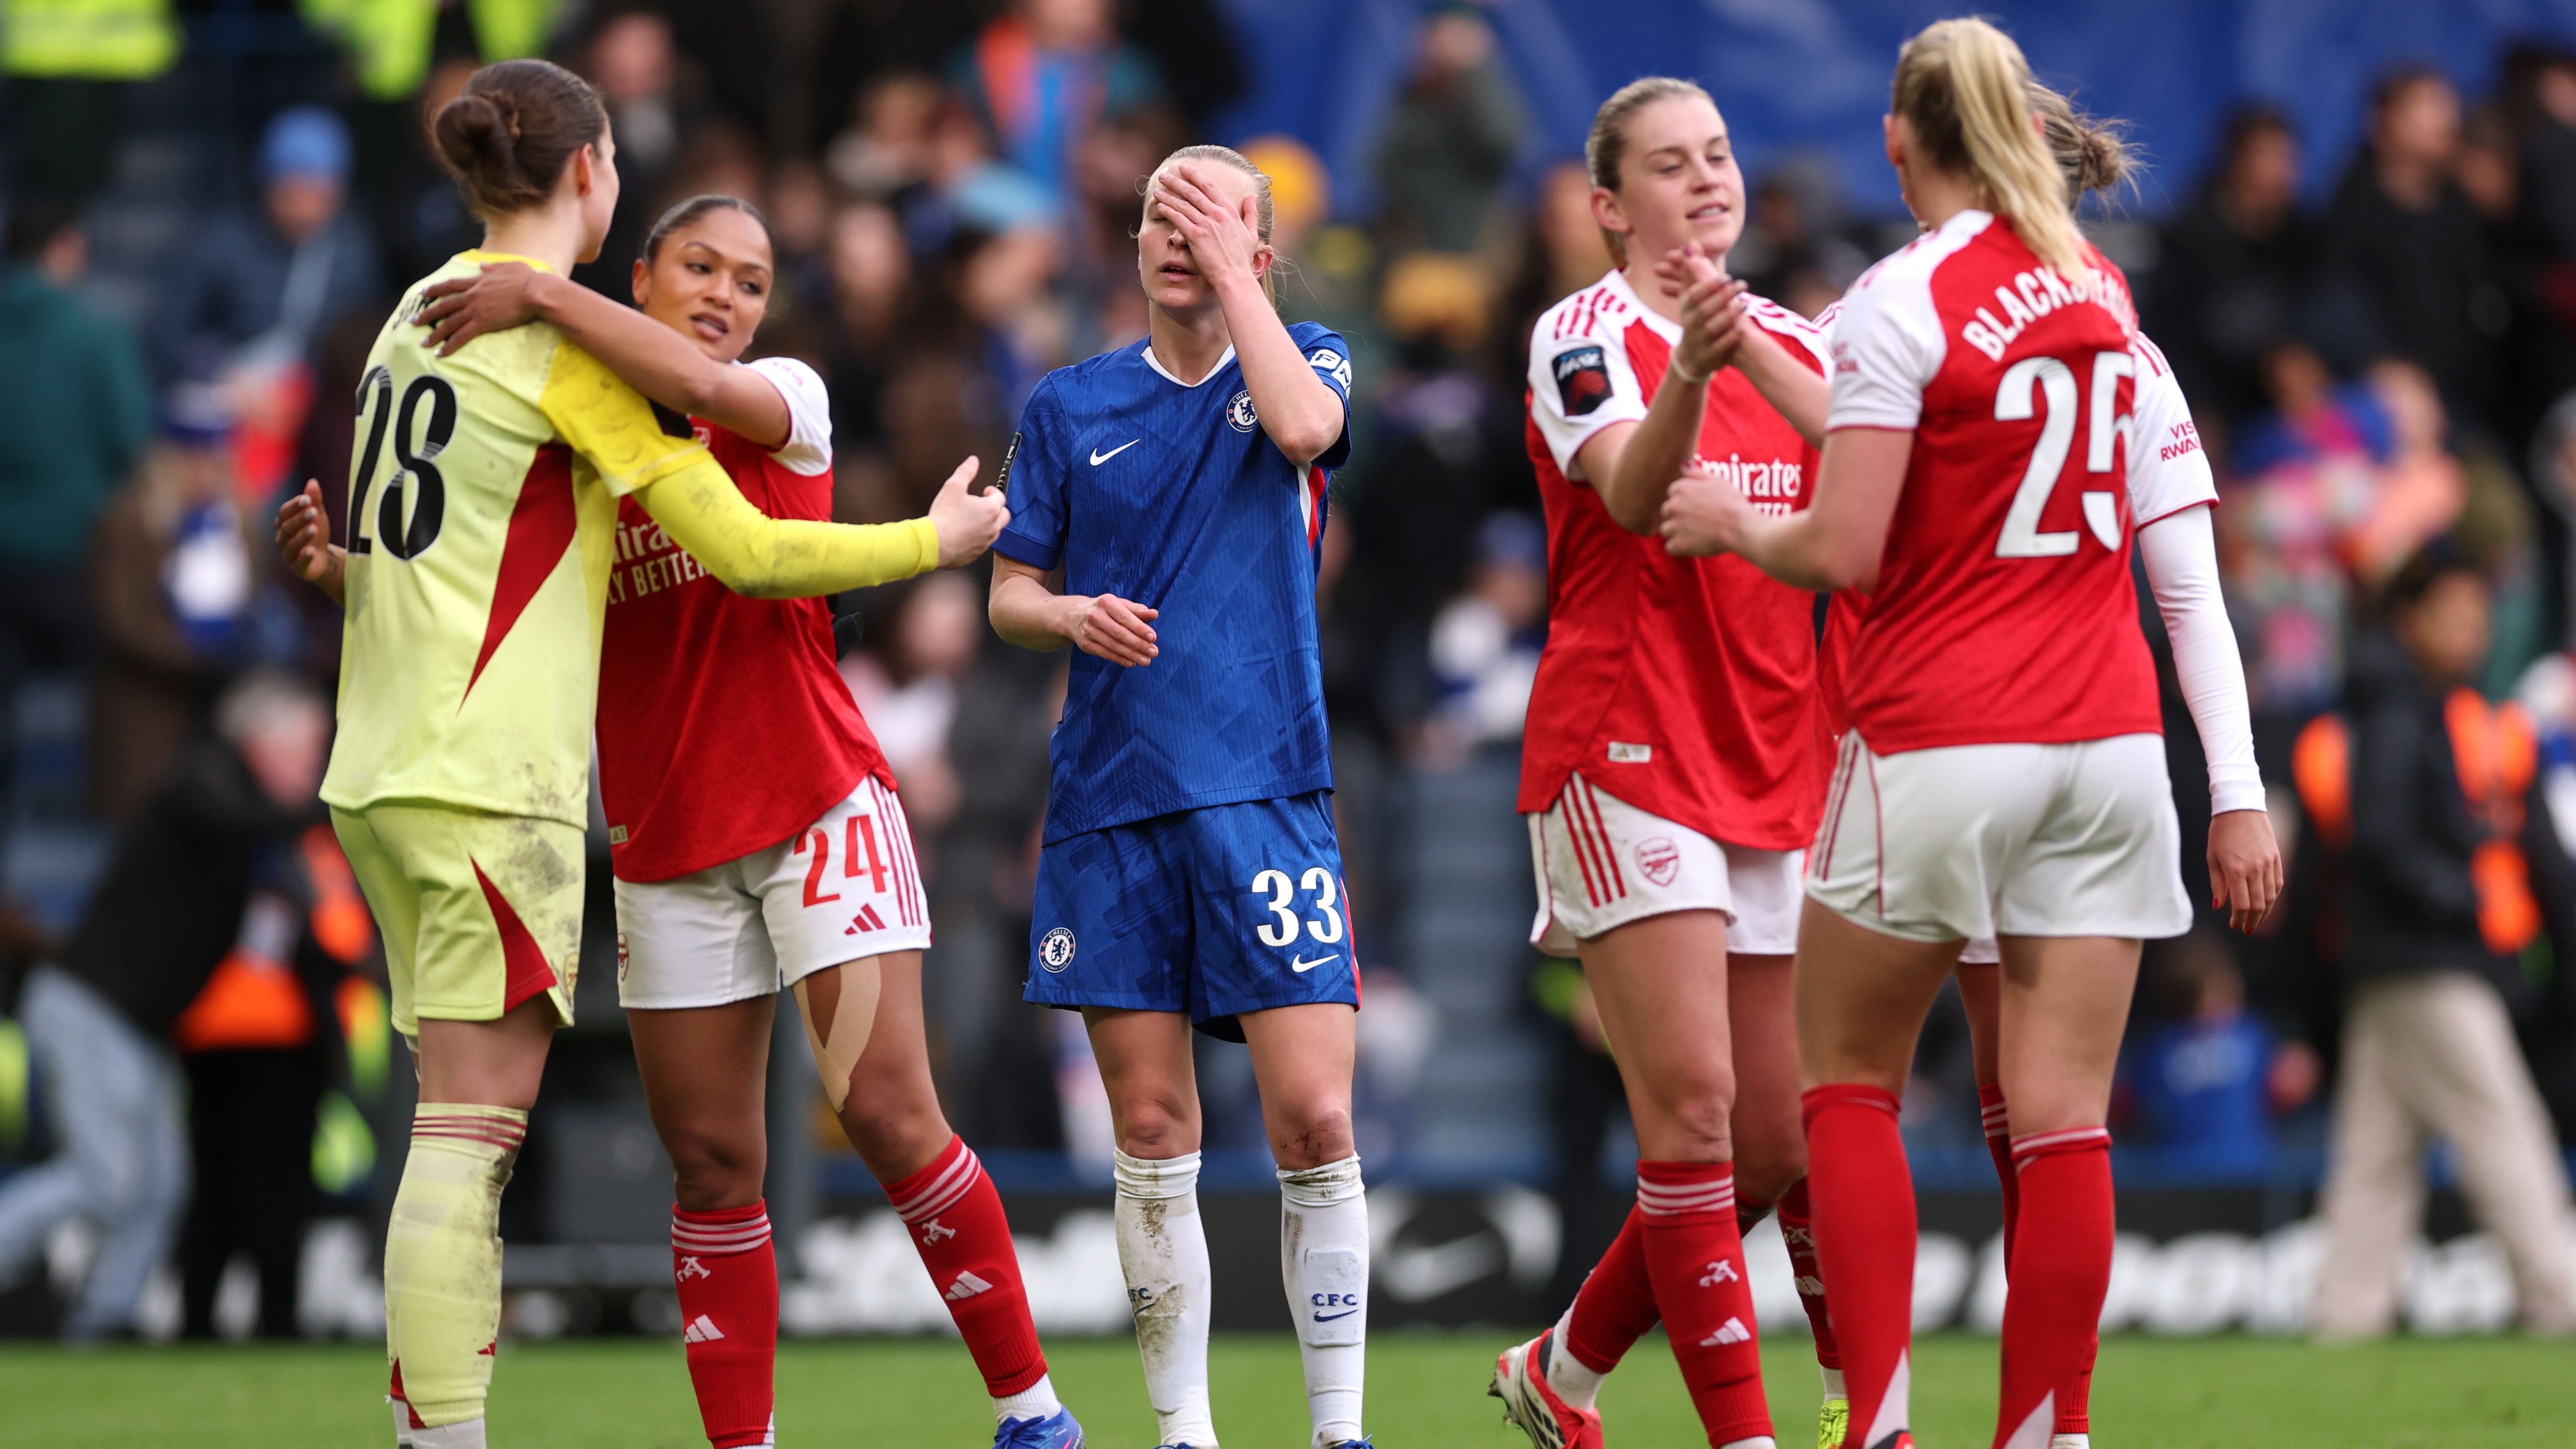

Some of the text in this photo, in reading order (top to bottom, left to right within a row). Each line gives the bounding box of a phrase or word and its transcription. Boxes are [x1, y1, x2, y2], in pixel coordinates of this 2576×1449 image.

[346, 365, 457, 561] 28
[1994, 351, 2134, 559] 25
[793, 813, 888, 909] 24
[1049, 929, 1072, 940] CHELSEA
[1252, 866, 1343, 947] 33
[1312, 1293, 1357, 1306] CFC
